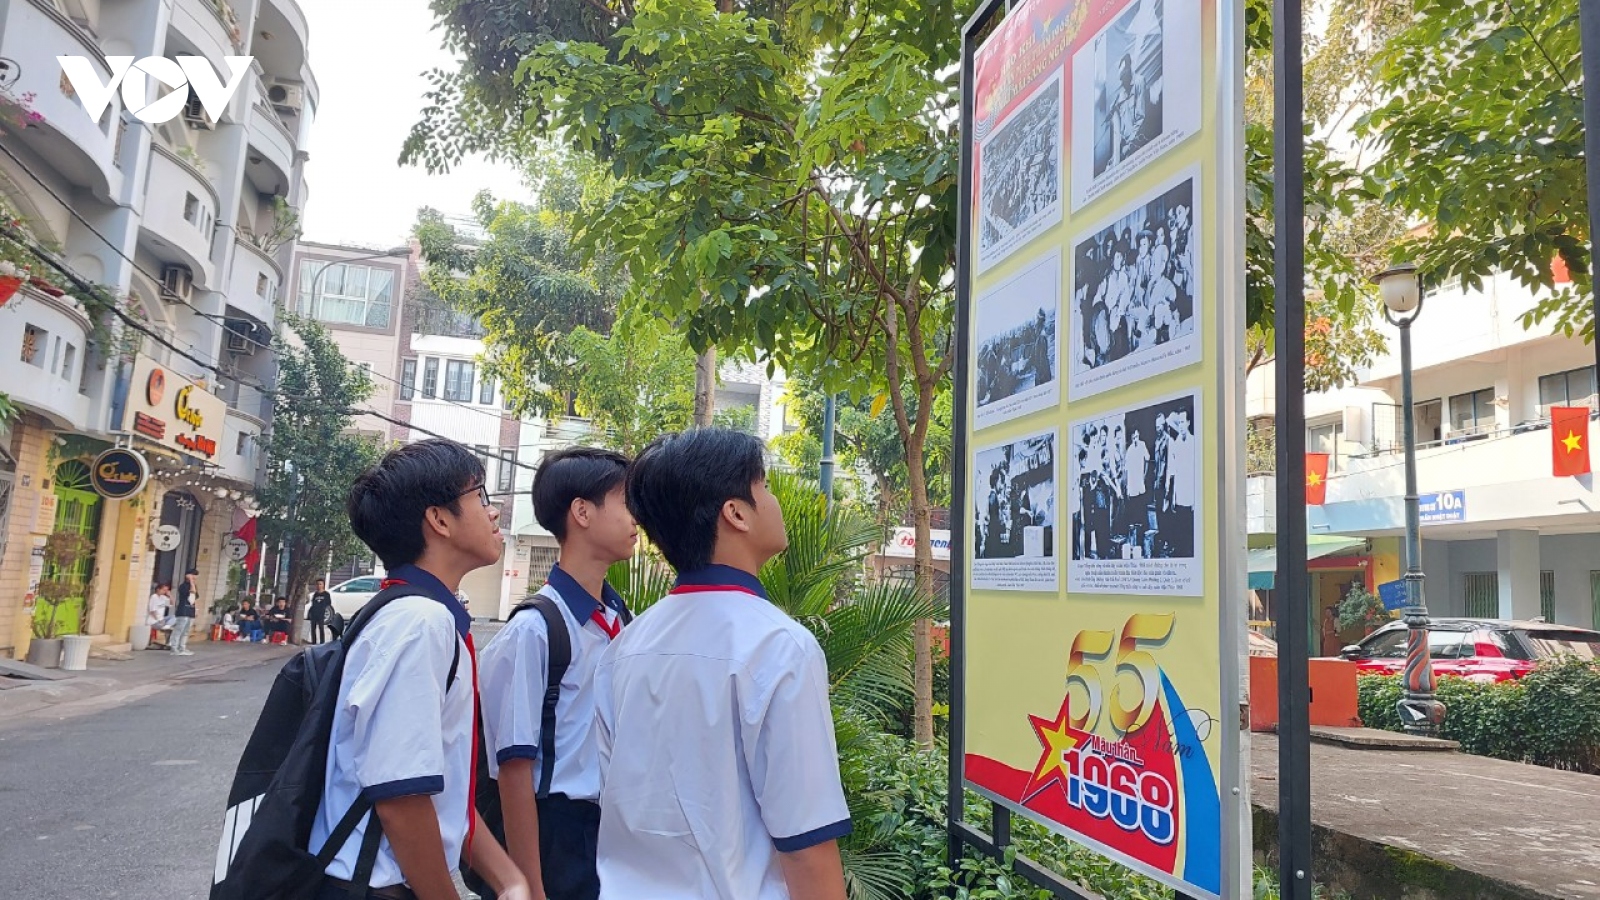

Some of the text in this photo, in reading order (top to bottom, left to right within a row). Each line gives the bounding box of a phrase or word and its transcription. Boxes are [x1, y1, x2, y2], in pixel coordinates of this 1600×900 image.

[1436, 493, 1462, 510] 10A
[1065, 611, 1175, 736] 55
[1061, 749, 1175, 845] 1968
